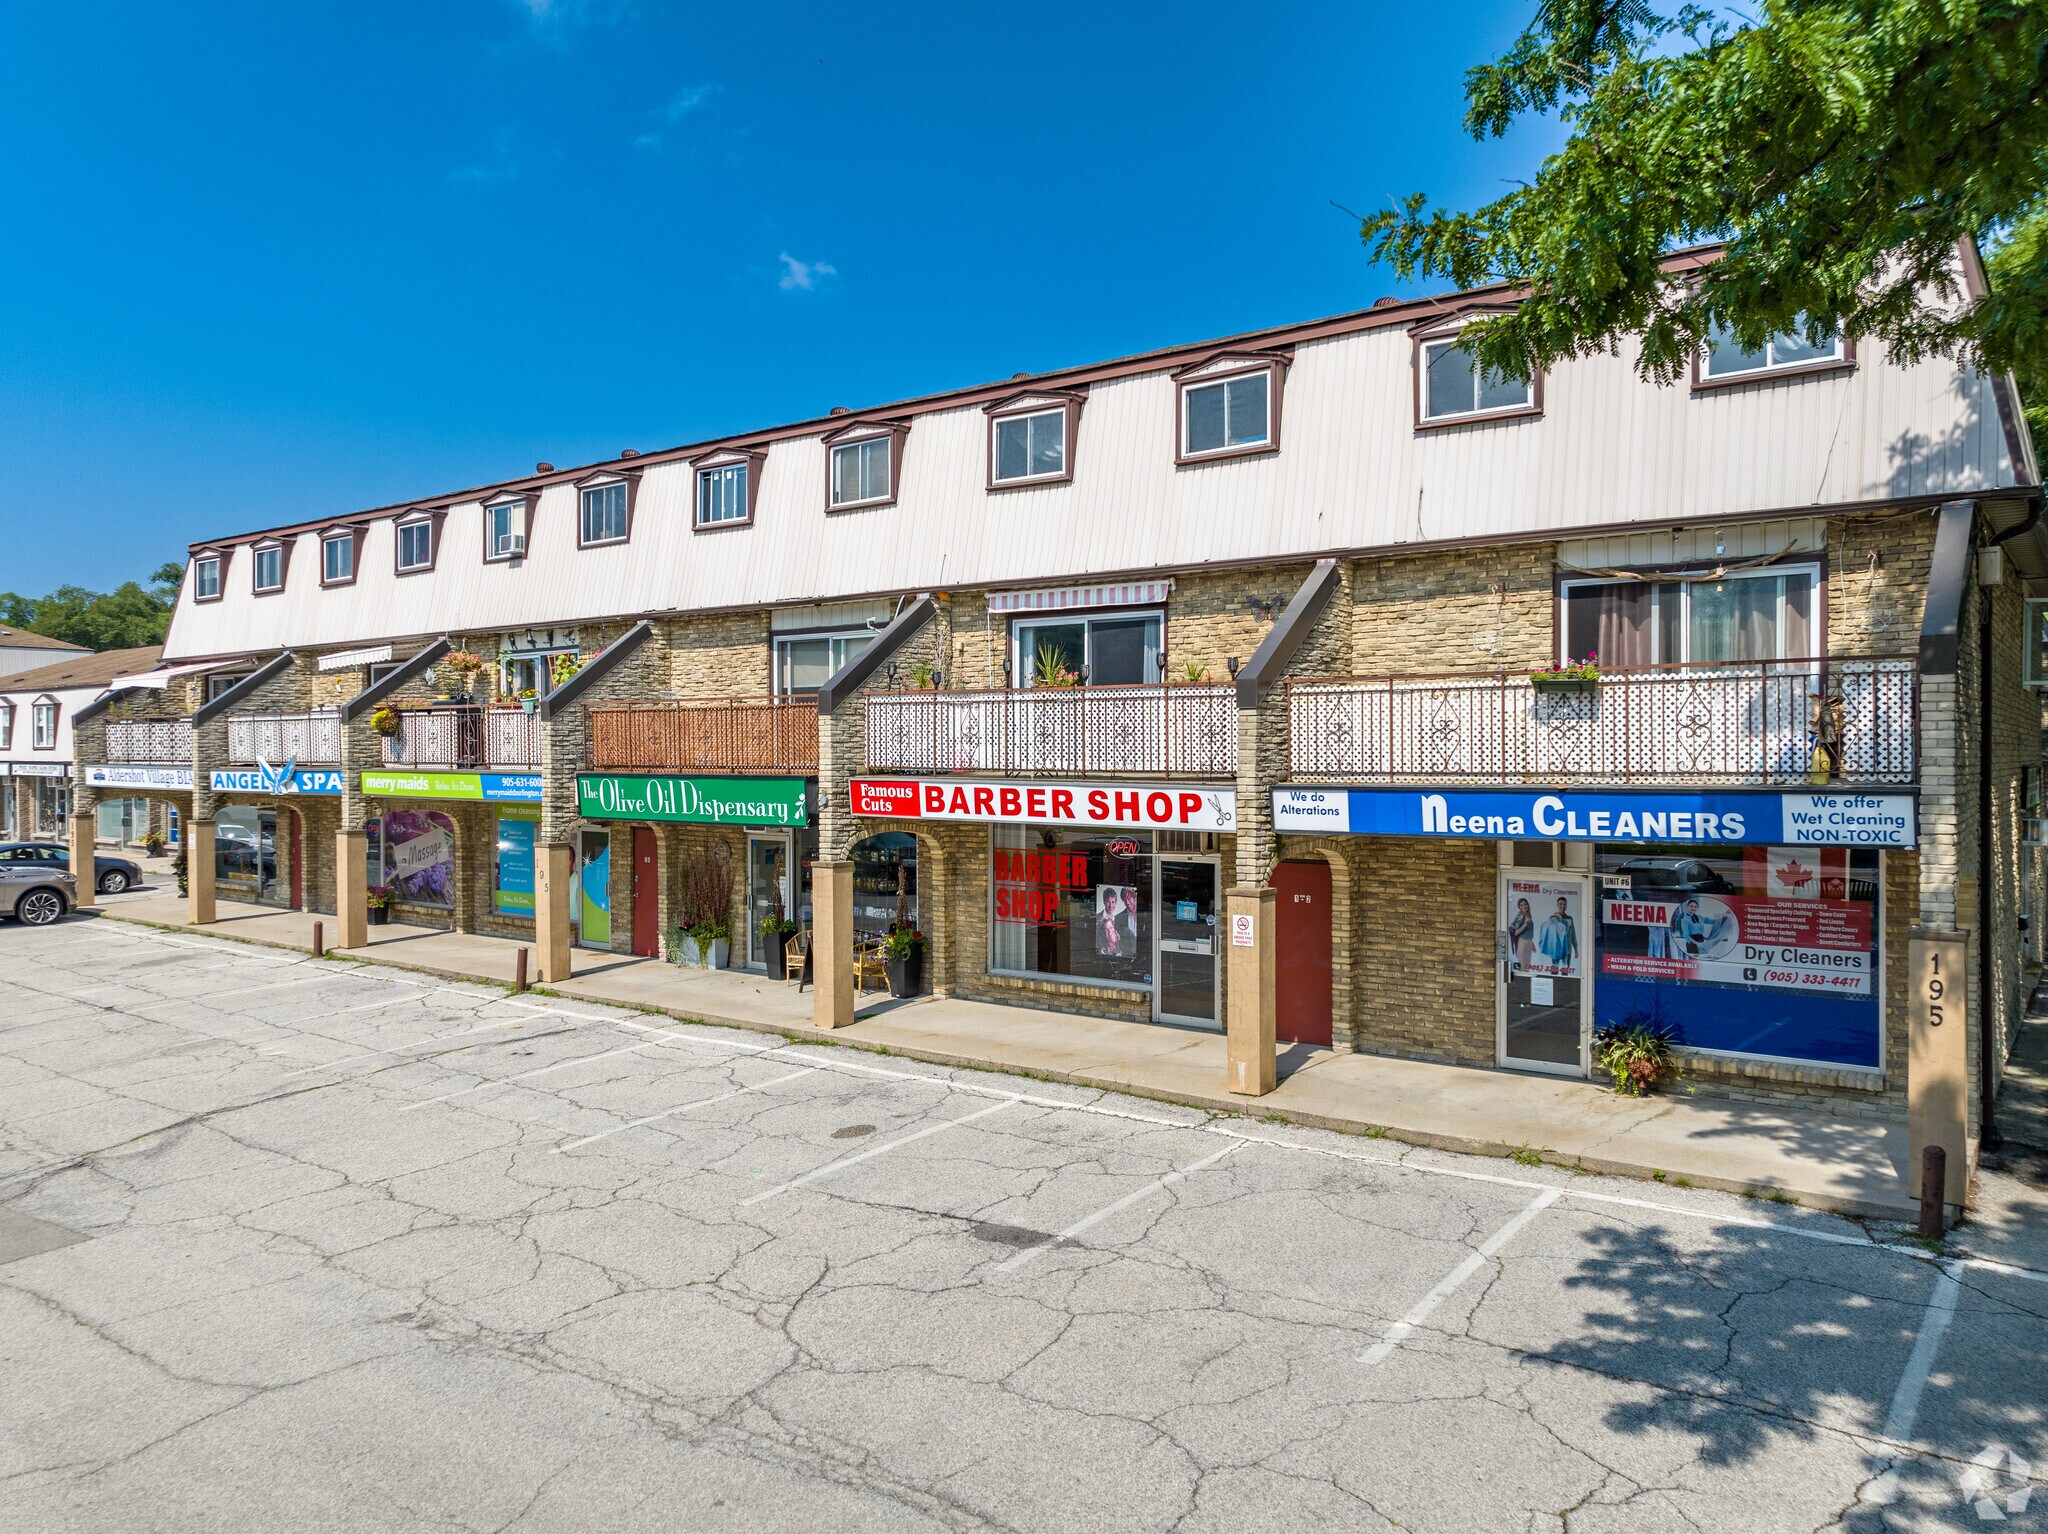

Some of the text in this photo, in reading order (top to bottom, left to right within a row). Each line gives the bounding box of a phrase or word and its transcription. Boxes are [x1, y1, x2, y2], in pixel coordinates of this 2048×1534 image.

[108, 768, 145, 783] Aldershot
[147, 769, 174, 787] Village
[213, 773, 342, 790] ANGEL SPA
[365, 776, 429, 792] merry maids
[581, 778, 788, 824] The Olive Oil Dispensary
[860, 783, 1203, 824] Famous BARBER SHOP
[1290, 791, 1325, 802] We do
[1811, 796, 1884, 809] We offer
[502, 806, 540, 817] Home cleaning
[860, 798, 893, 812] Cuts
[1280, 804, 1340, 816] Alterations
[1531, 796, 1746, 840] CLEANERS
[1791, 812, 1905, 829] Wet Cleaning
[1796, 829, 1901, 843] NON-TOXIC
[408, 841, 442, 867] Massage
[1110, 841, 1138, 854] OPEN
[995, 852, 1088, 887] BARBER
[1512, 883, 1540, 894] NEENA
[1554, 888, 1578, 896] Cleaners
[1620, 878, 1630, 886] #6
[996, 887, 1059, 921] SHOP
[1793, 902, 1828, 910] SERVICES
[1611, 903, 1667, 923] NEENA
[1610, 957, 1644, 965] ALTERATION
[1644, 959, 1667, 967] SERVICE
[1745, 946, 1862, 968] Dry Cleaners
[1648, 967, 1675, 975] SERVICES
[1763, 969, 1861, 988] (905) 333-4411
